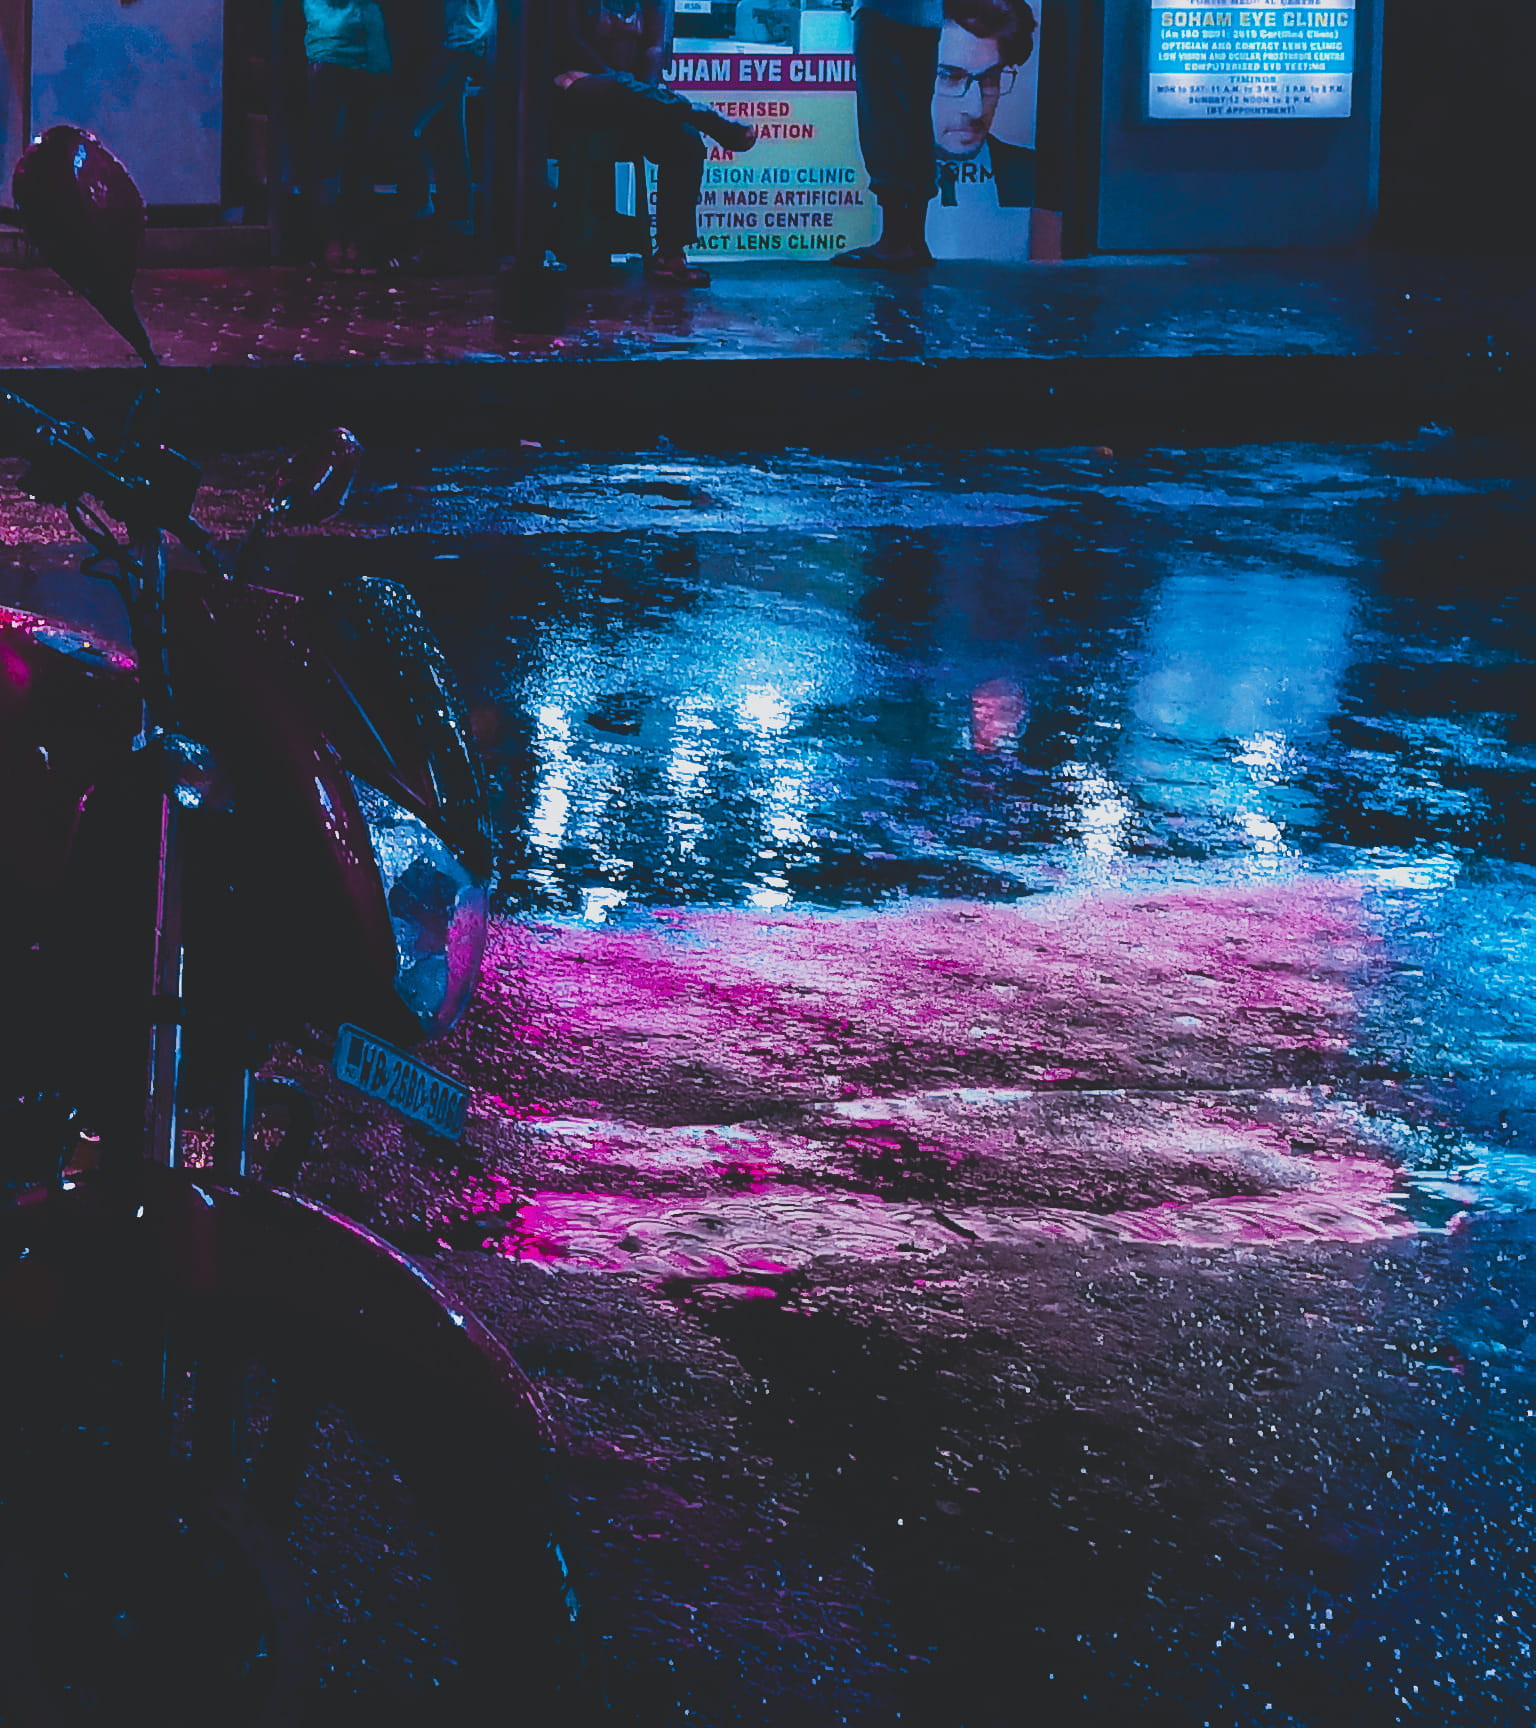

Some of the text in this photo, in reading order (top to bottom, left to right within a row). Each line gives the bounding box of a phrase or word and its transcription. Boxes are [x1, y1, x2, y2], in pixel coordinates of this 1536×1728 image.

[1161, 12, 1349, 27] SOHAM EYE CLINIC
[1162, 42, 1208, 50] OPTICIAN
[662, 59, 731, 82] OHAM
[739, 59, 782, 82] EYE
[710, 101, 790, 117] TERISED
[706, 168, 856, 183] ISION AID CLINIC
[724, 191, 768, 205] MADE
[775, 191, 864, 205] ARTIFICIAL
[698, 213, 833, 228] ITTING CENTRE
[737, 235, 781, 249] LENS
[788, 235, 846, 249] CLINIC
